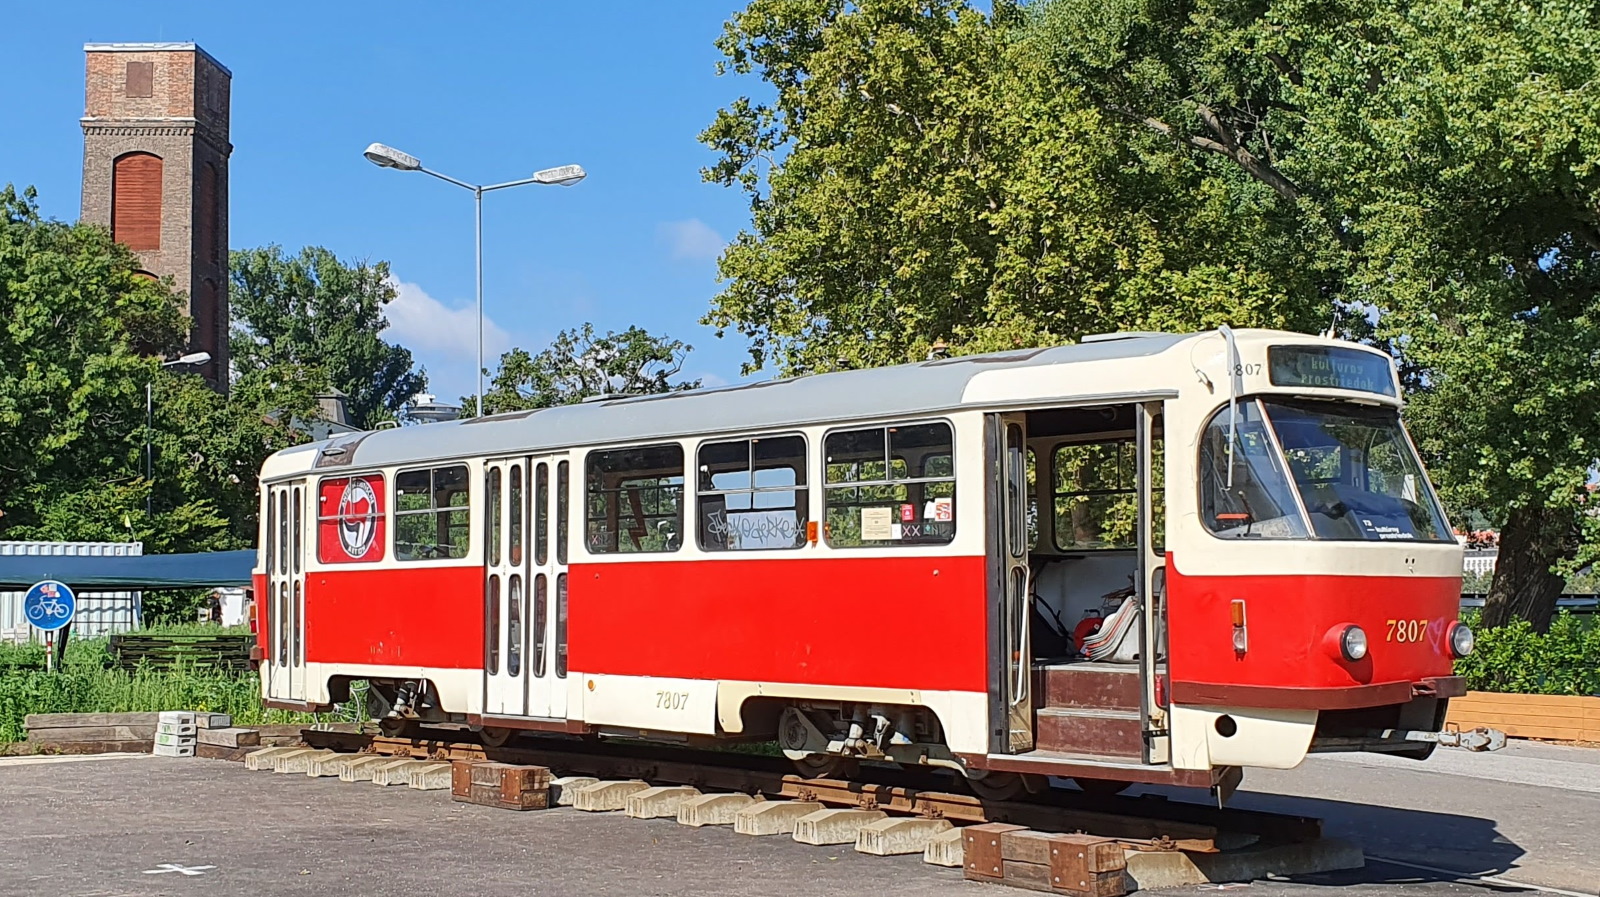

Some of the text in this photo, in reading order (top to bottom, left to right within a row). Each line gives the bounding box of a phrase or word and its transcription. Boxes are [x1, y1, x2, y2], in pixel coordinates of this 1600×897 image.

[1228, 363, 1262, 377] 807
[1387, 619, 1428, 643] 7807
[656, 691, 689, 710] 7807
